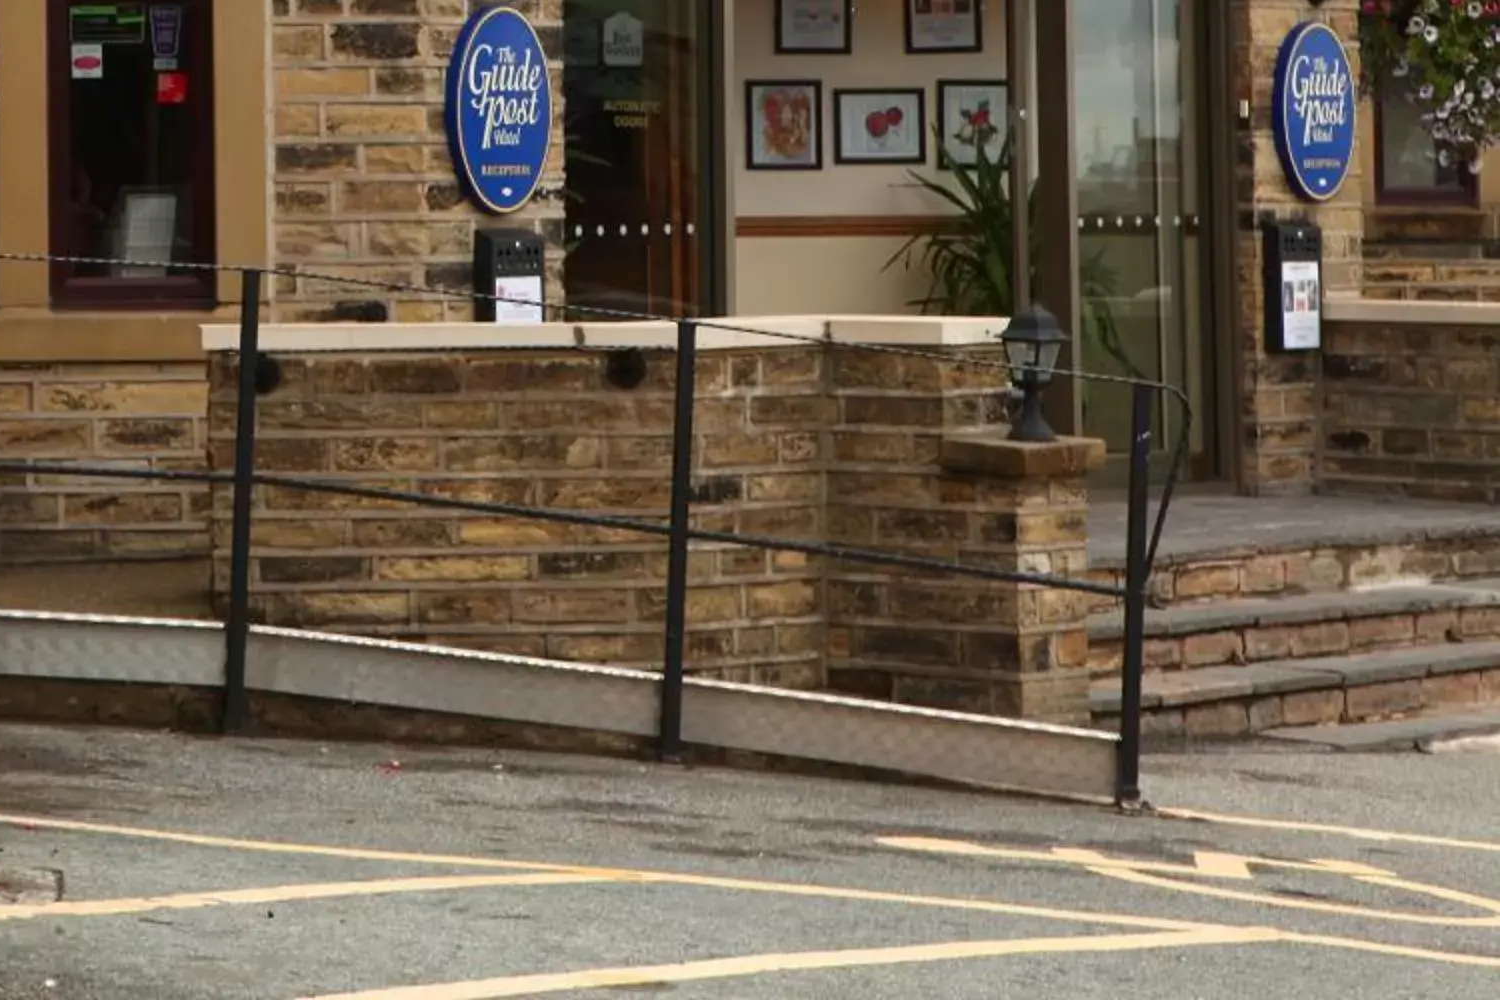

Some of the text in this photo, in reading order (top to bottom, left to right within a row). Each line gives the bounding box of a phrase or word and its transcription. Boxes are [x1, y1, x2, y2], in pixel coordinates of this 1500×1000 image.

[469, 43, 543, 98] Guide
[497, 46, 516, 64] The
[1292, 55, 1348, 100] Guide
